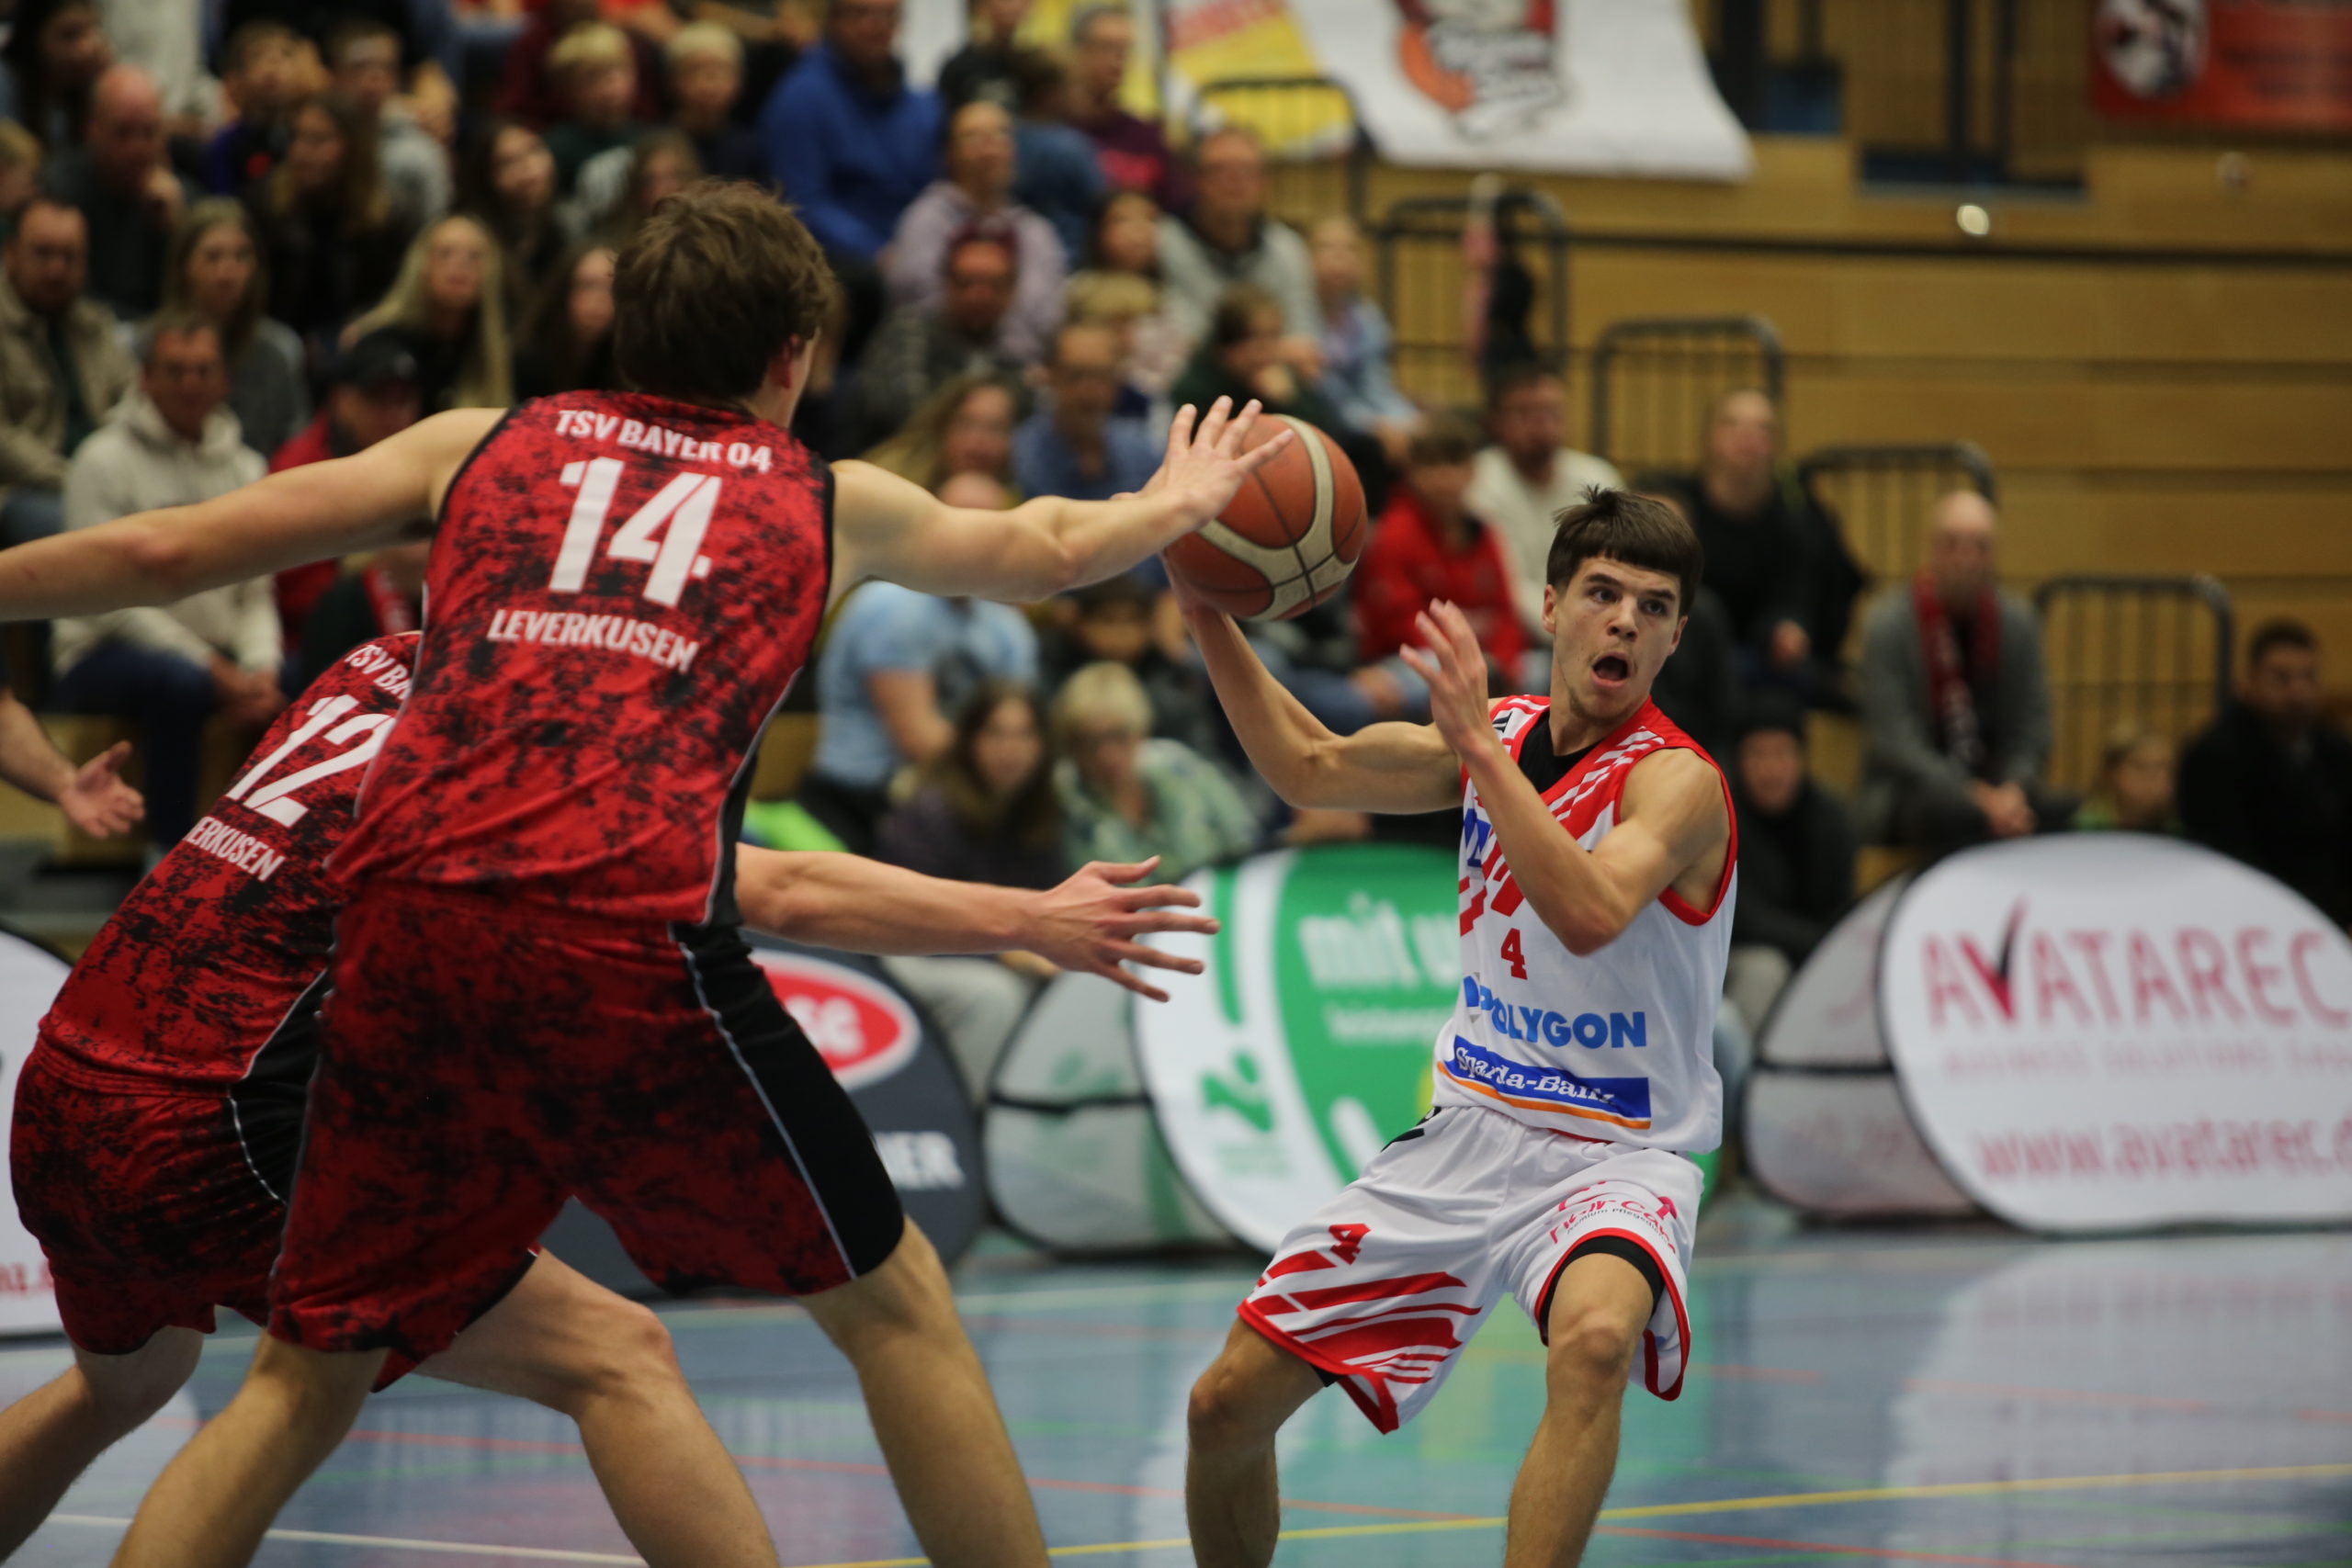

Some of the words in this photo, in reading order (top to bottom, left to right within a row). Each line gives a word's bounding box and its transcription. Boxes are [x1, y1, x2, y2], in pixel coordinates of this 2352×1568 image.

[555, 410, 621, 440] TSV
[617, 418, 723, 462] BAYER
[727, 442, 773, 474] 04
[548, 457, 722, 608] 14
[345, 644, 396, 675] TSV
[372, 663, 413, 700] BA
[486, 608, 700, 674] LEVERKUSEN
[225, 694, 396, 828] 12
[183, 816, 285, 882] ERKUSEN
[1499, 927, 1528, 980] 4
[1329, 1223, 1371, 1265] 4
